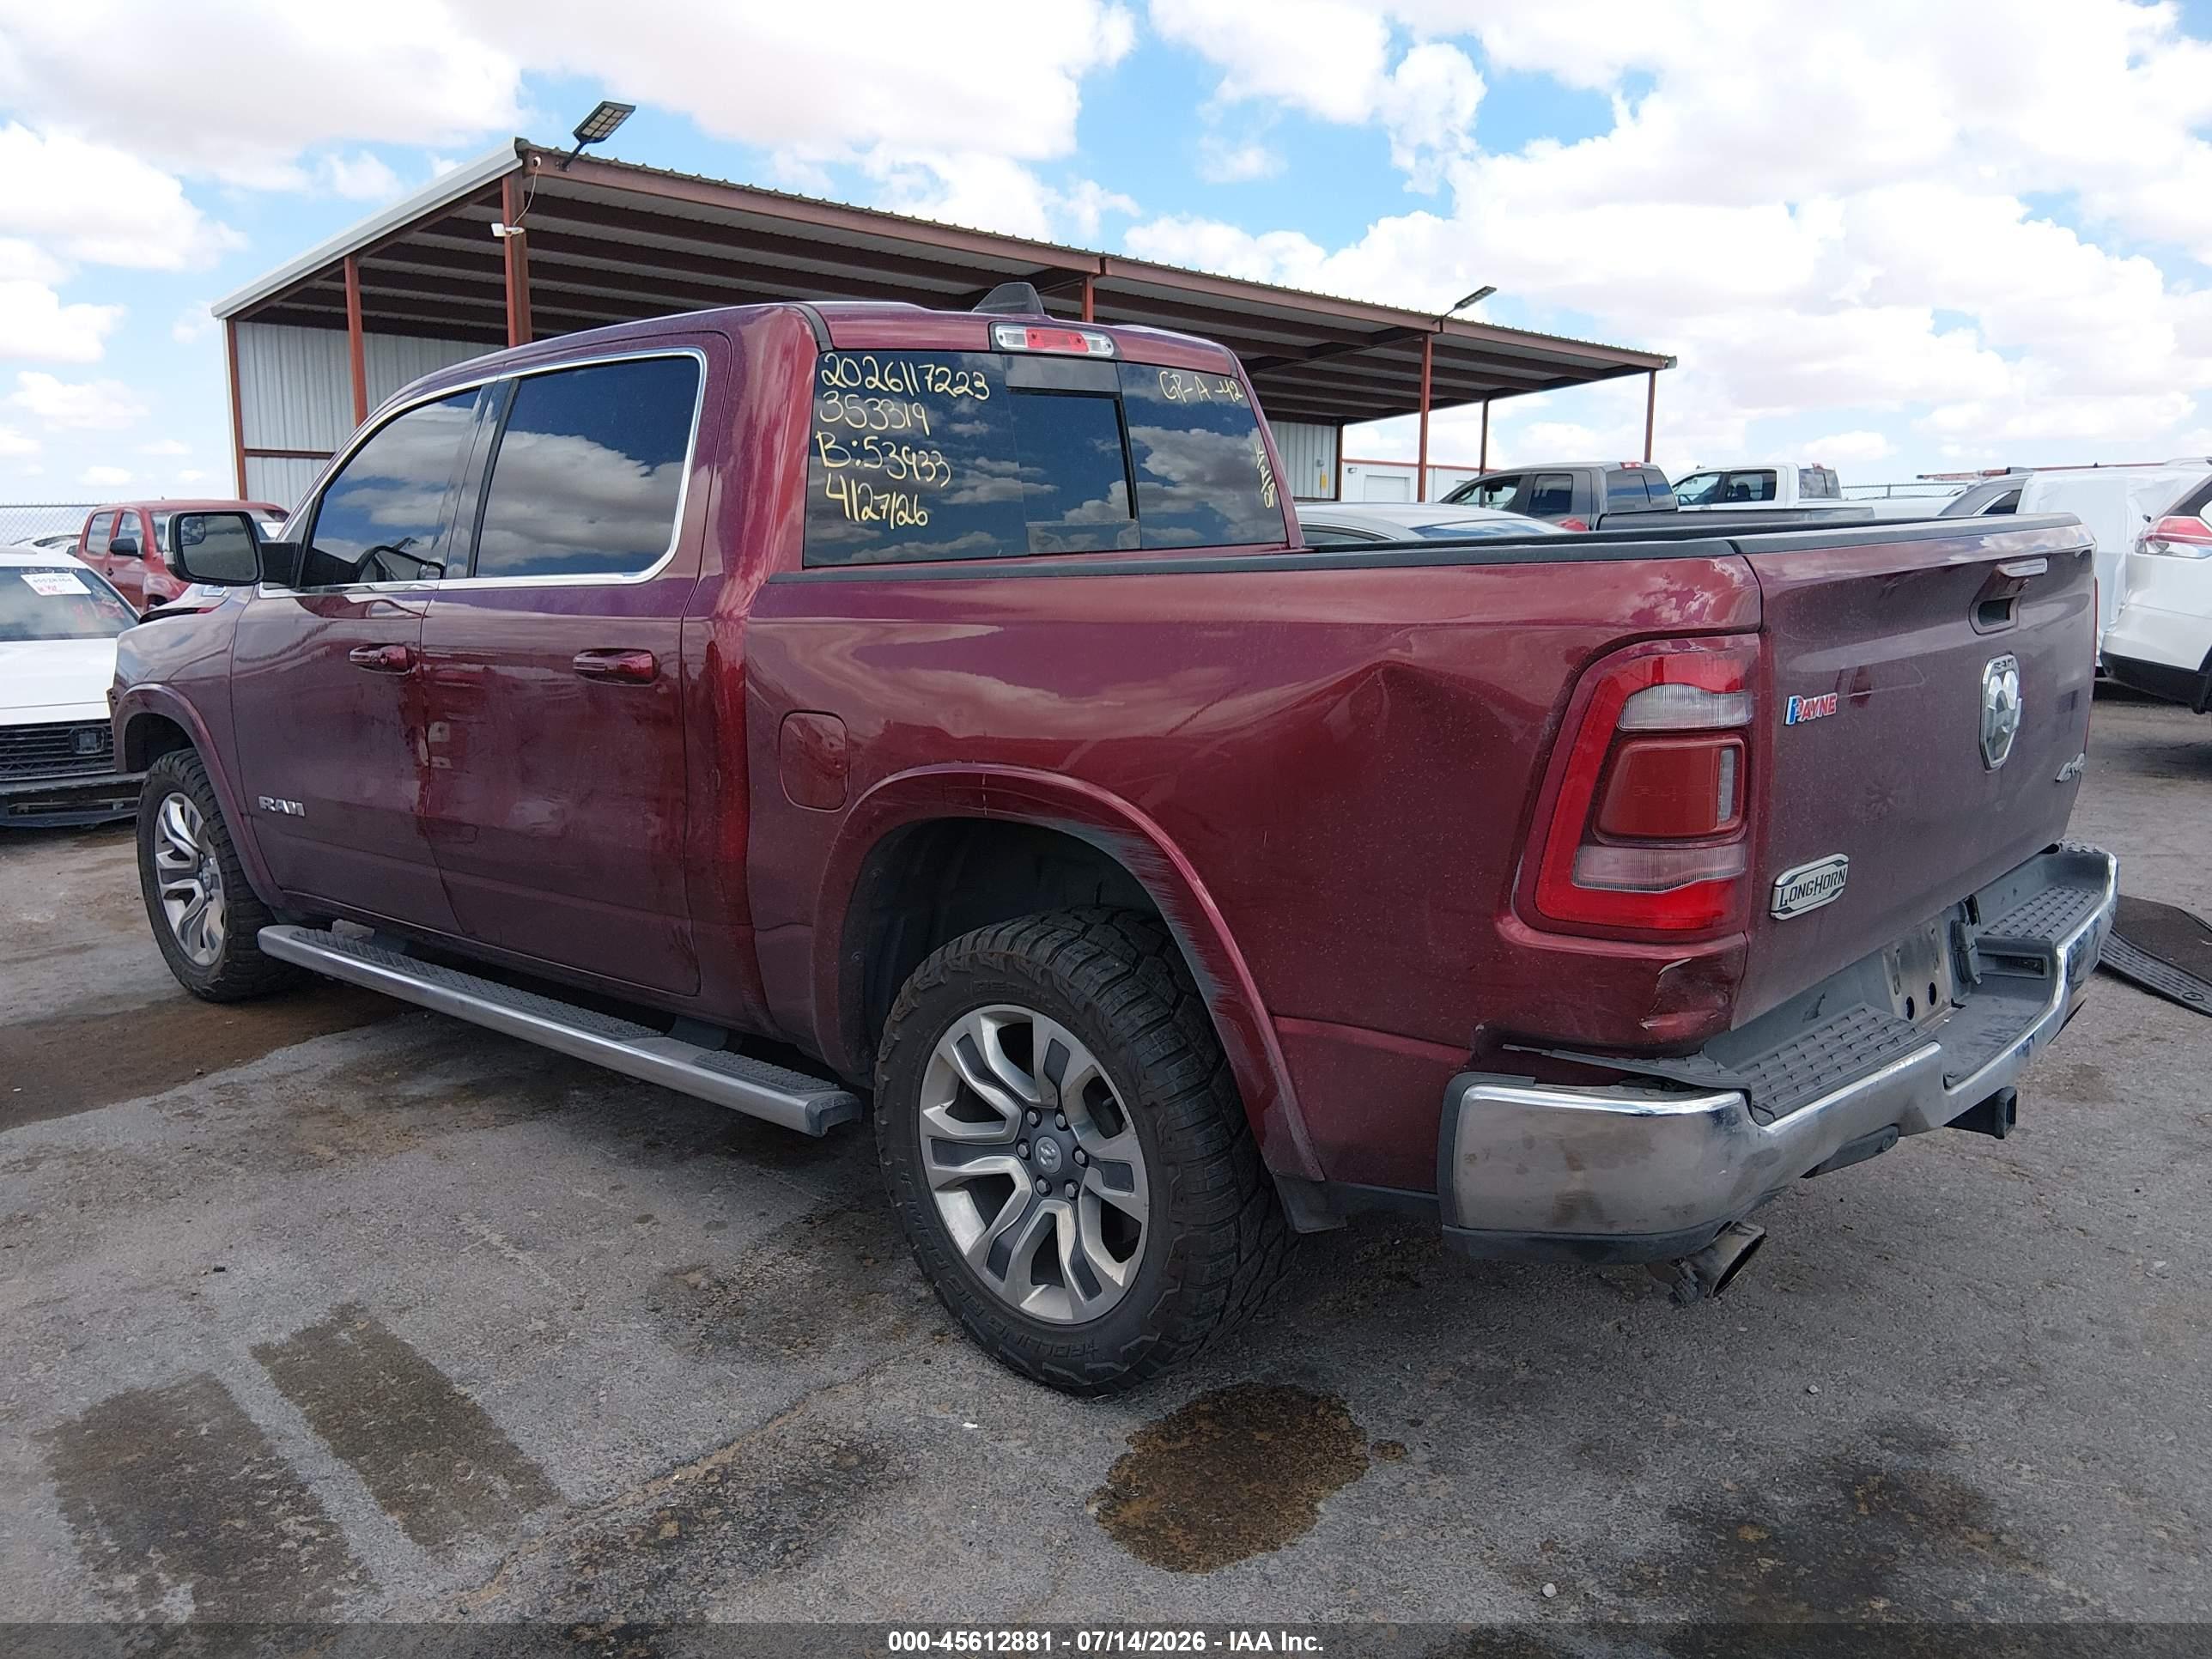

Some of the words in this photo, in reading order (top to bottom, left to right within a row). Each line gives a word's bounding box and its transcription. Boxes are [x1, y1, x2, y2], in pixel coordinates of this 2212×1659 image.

[819, 390, 931, 436] 353319
[1784, 692, 1838, 725] PAYNE
[258, 795, 307, 817] RAM
